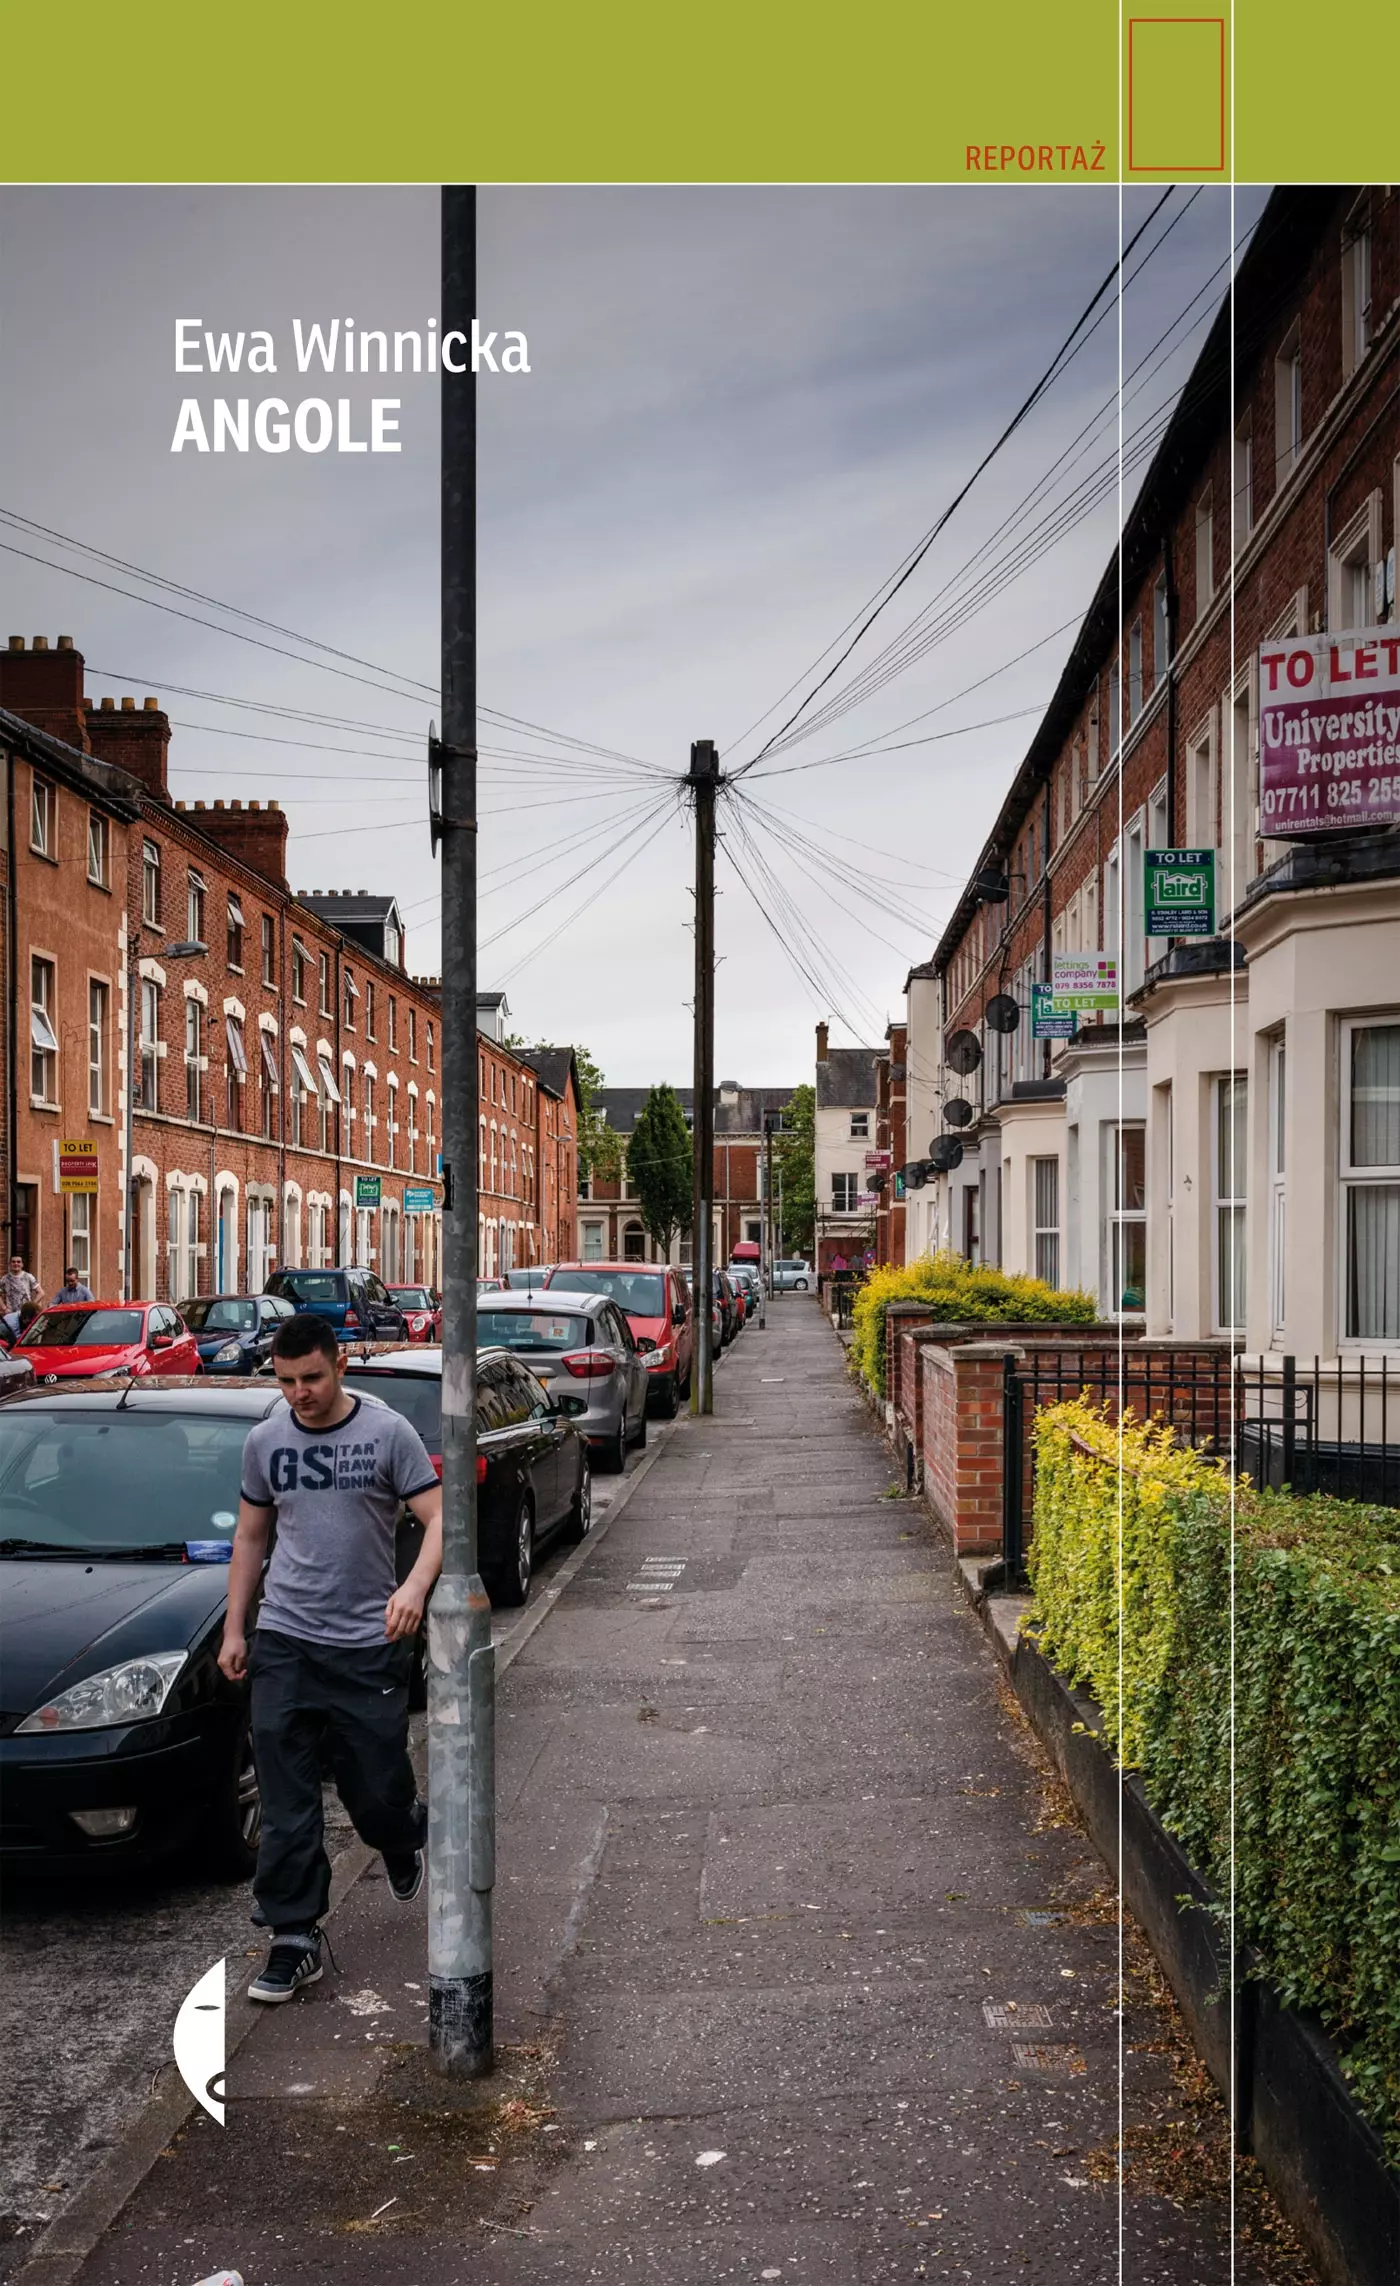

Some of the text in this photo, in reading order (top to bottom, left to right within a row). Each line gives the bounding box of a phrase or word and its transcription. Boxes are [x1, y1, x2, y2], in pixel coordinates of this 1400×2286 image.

[1261, 638, 1400, 691] TO LET
[1264, 700, 1400, 748] University
[1264, 775, 1400, 814] 07711 825 255
[1156, 853, 1203, 863] TO LET
[1055, 960, 1089, 970] lettings
[1054, 970, 1098, 979] company
[1054, 999, 1071, 1008] TO
[1075, 998, 1096, 1008] LET
[64, 1143, 92, 1152] TO LET
[270, 1443, 374, 1492] GS TAR
[338, 1459, 377, 1472] RAW
[339, 1476, 376, 1490] DNM
